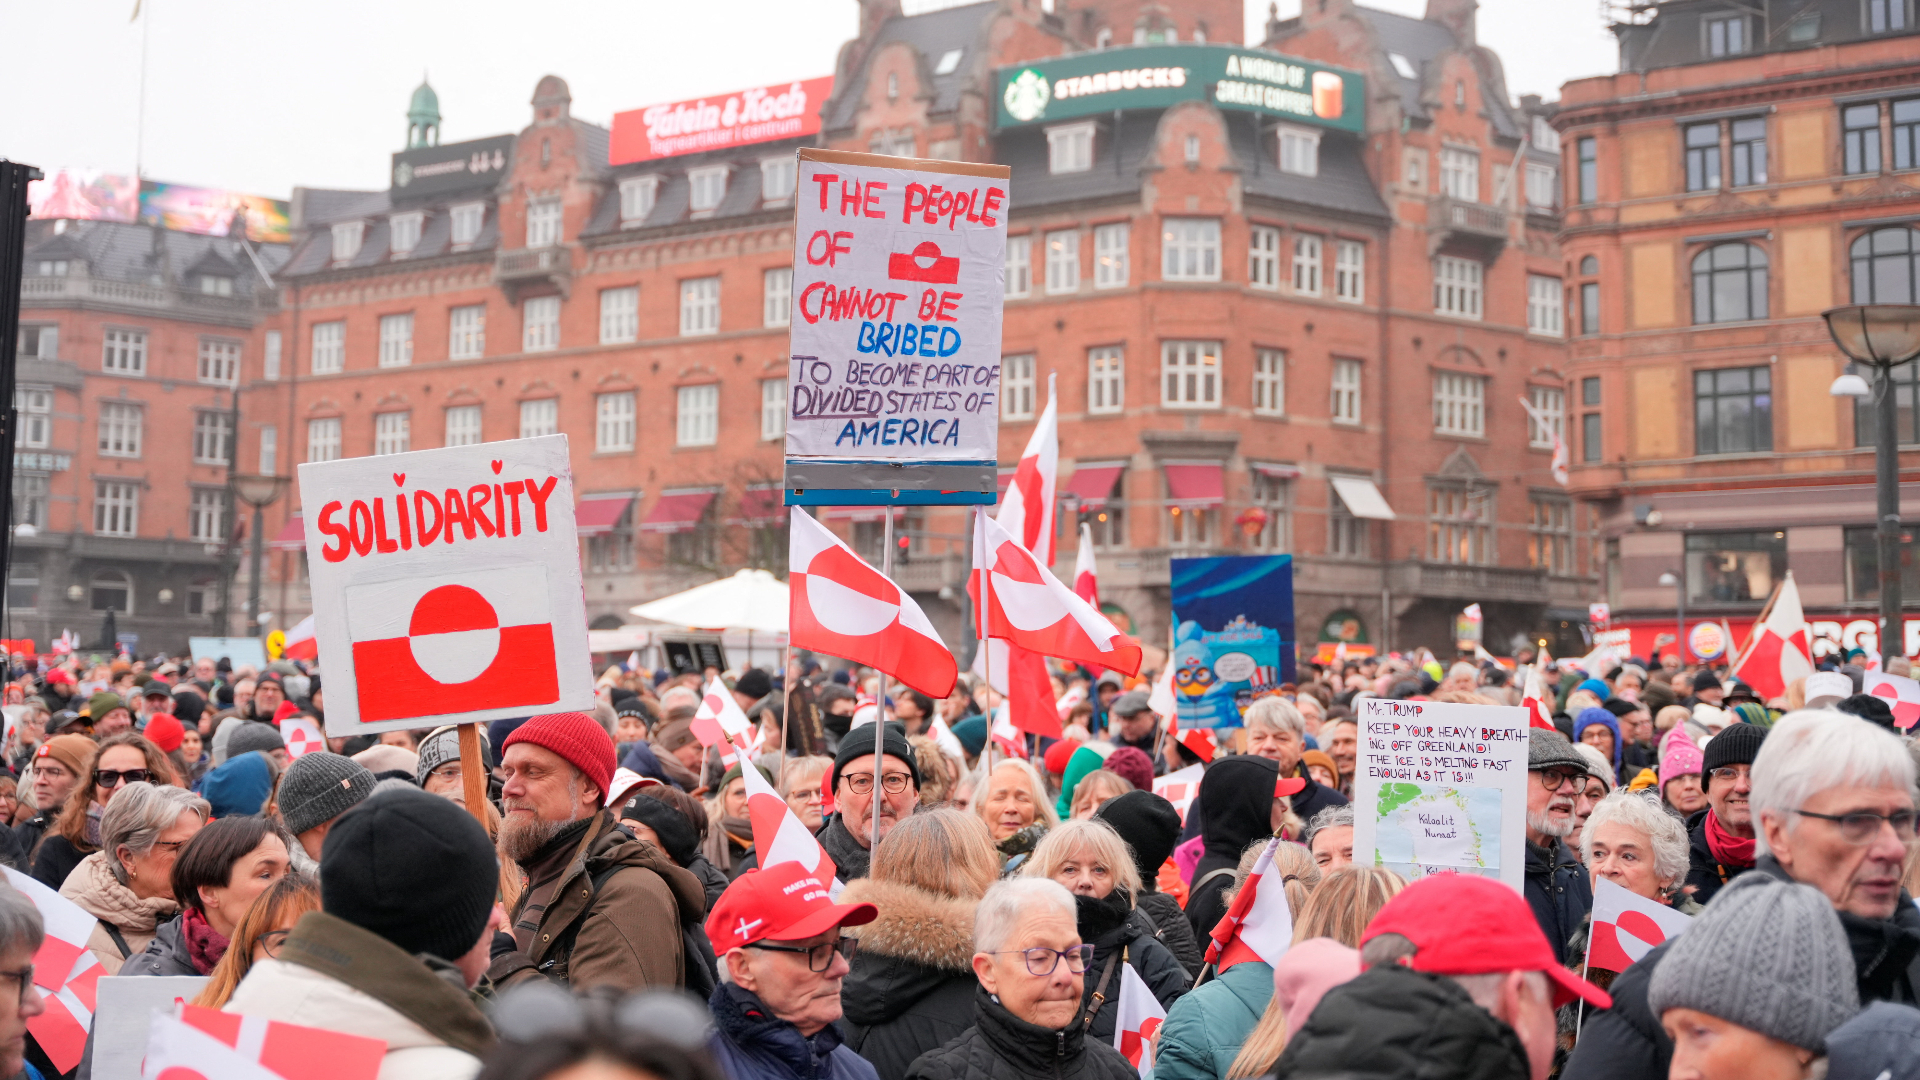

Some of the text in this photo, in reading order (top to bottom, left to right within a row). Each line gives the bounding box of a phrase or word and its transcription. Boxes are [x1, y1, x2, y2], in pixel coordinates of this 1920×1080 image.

[1054, 67, 1186, 99] STARBUCKS
[1226, 55, 1306, 88] A WORLD OF
[722, 97, 740, 127] &
[739, 81, 807, 124] Koch
[1216, 80, 1265, 106] GREAT
[742, 118, 802, 140] centrum
[812, 174, 1005, 231] THE PEOPLE
[806, 229, 854, 268] OF
[799, 281, 963, 324] CANNOT BE
[857, 321, 962, 357] BRIBED
[791, 355, 1000, 388] TO BECOME PART OF
[886, 390, 962, 415] STATES
[964, 393, 995, 415] OF
[835, 418, 960, 447] AMERICA
[1367, 702, 1423, 717] Mr. TRUMP
[1368, 721, 1528, 742] KEEP YOUR HEAVY BREATH-
[1391, 740, 1412, 751] OFF
[1418, 741, 1491, 754] GREENLAND!
[1366, 754, 1391, 765] THE
[1483, 759, 1512, 771] FAST
[1369, 767, 1411, 781] ENOUGH
[1415, 769, 1431, 782] AS
[1418, 813, 1455, 826] Kalaalit
[783, 880, 806, 895] MAKE
[803, 891, 815, 901] GO
